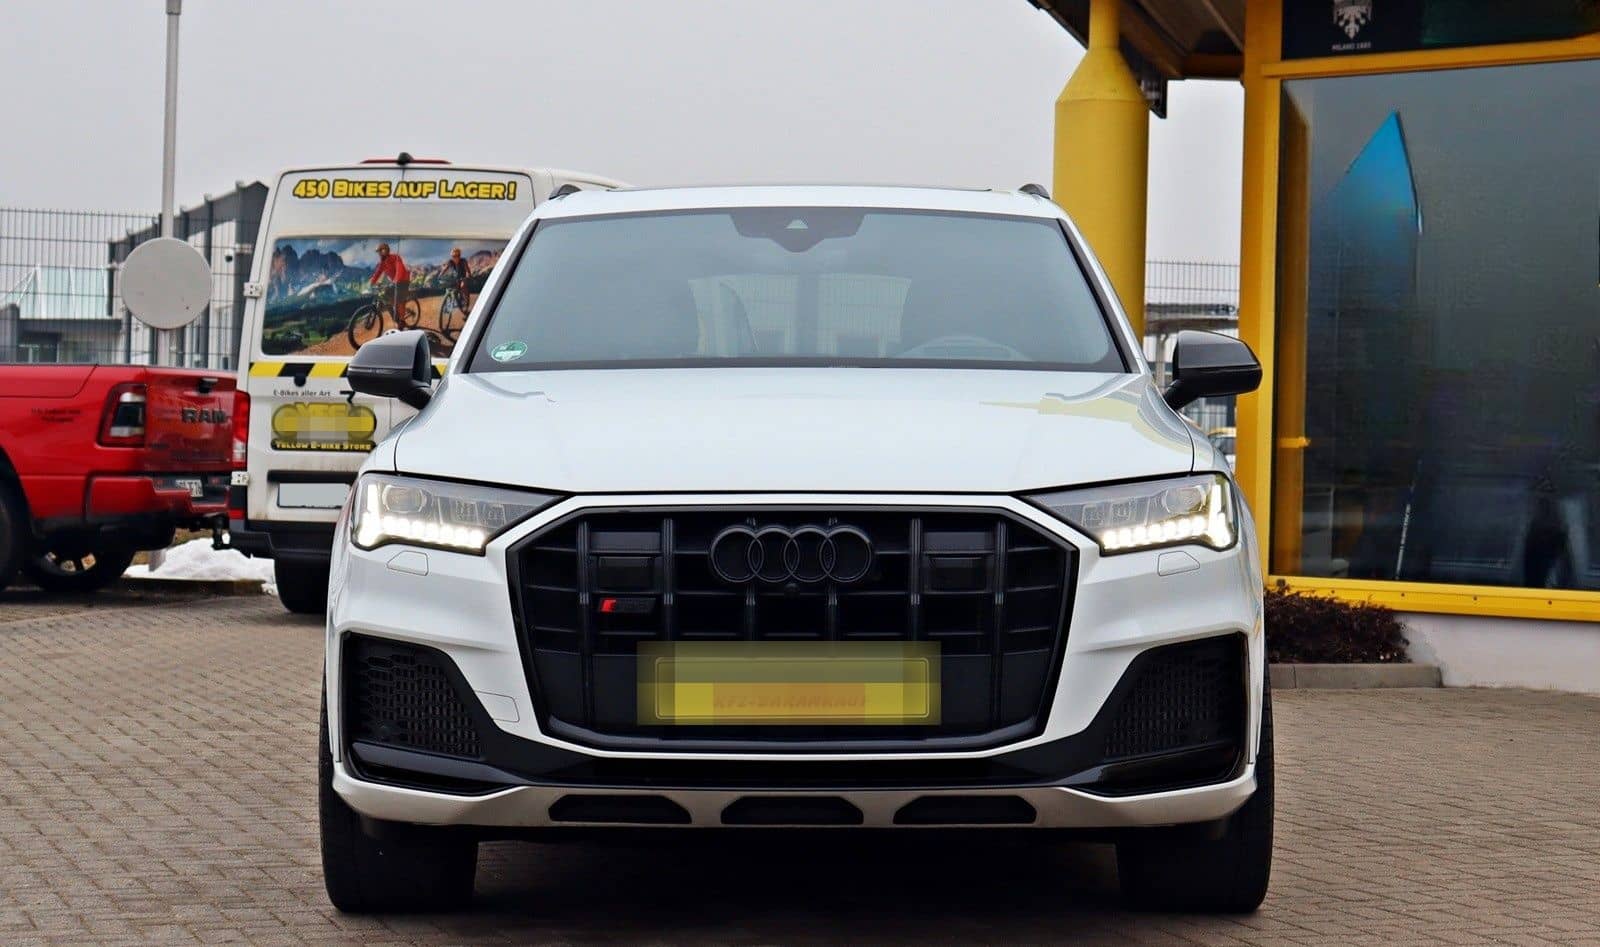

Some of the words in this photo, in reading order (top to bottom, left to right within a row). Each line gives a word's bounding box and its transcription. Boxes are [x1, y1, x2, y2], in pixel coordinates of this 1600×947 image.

[292, 179, 330, 198] 450
[331, 179, 392, 198] BIKES
[394, 180, 436, 199] AUF
[181, 407, 226, 423] RAM
